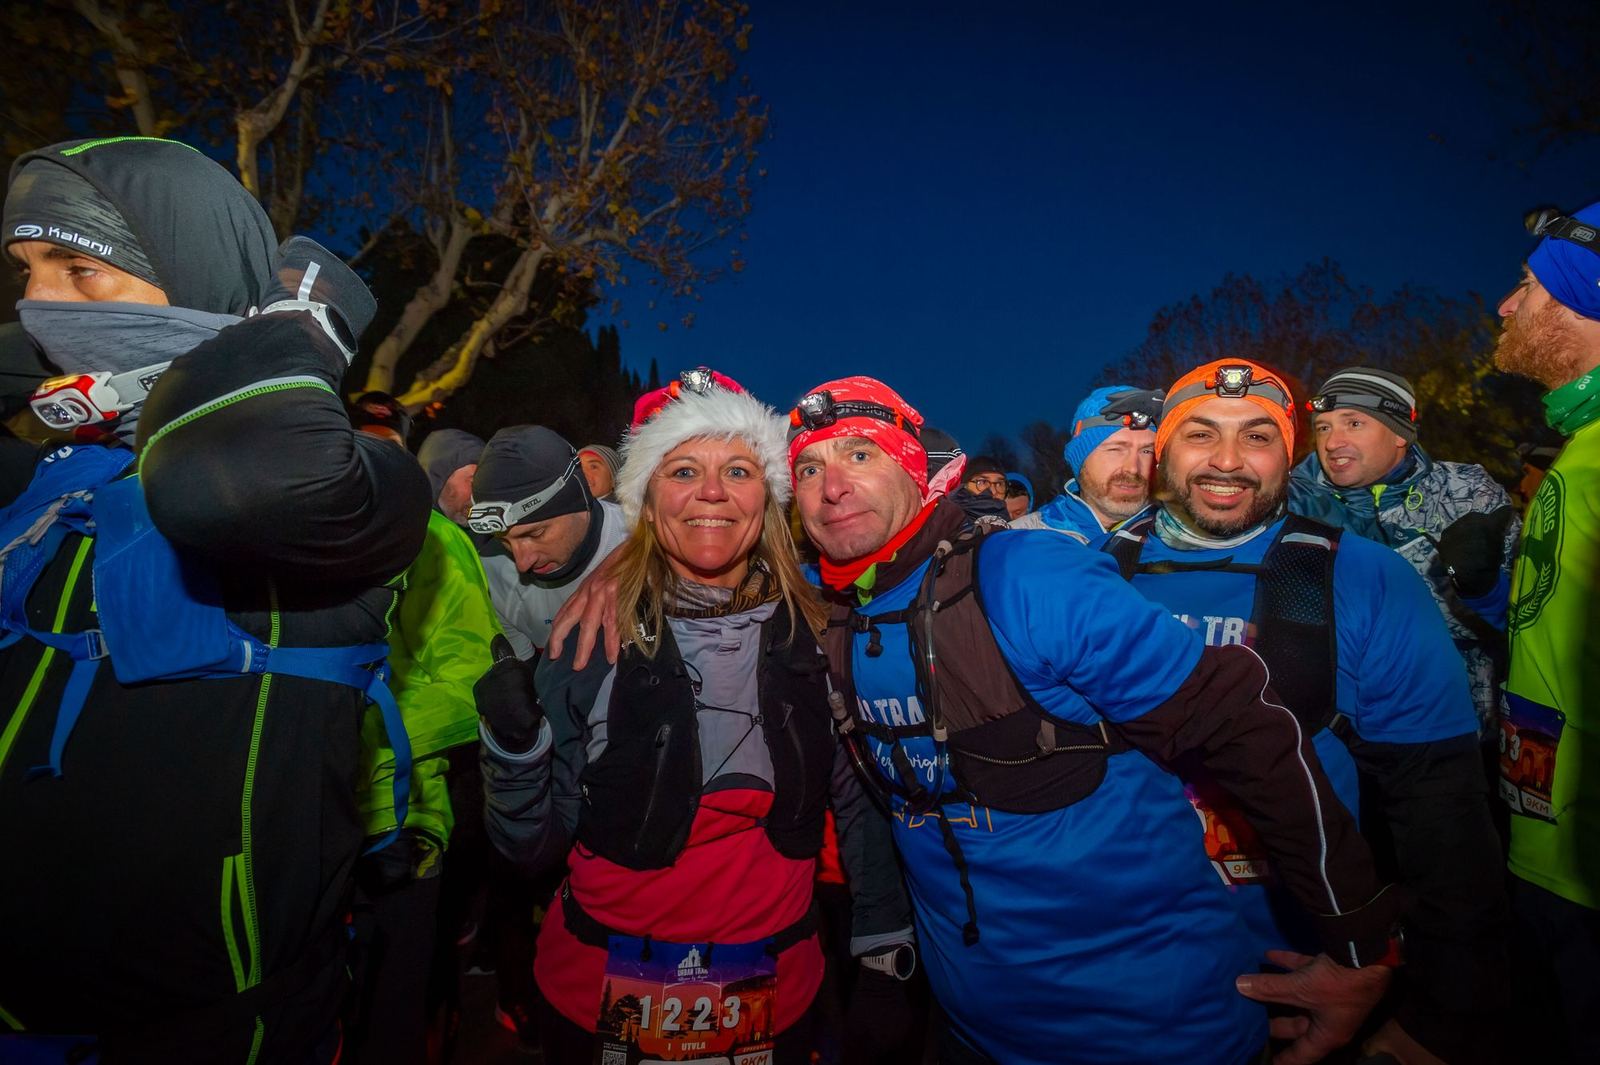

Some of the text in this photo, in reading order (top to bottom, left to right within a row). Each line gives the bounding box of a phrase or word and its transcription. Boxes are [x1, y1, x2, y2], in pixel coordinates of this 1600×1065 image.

[521, 498, 542, 512] PETZL
[873, 695, 926, 726] TRA
[1526, 797, 1549, 814] 9KM
[639, 995, 741, 1032] 1223
[681, 1041, 706, 1052] UTVLA
